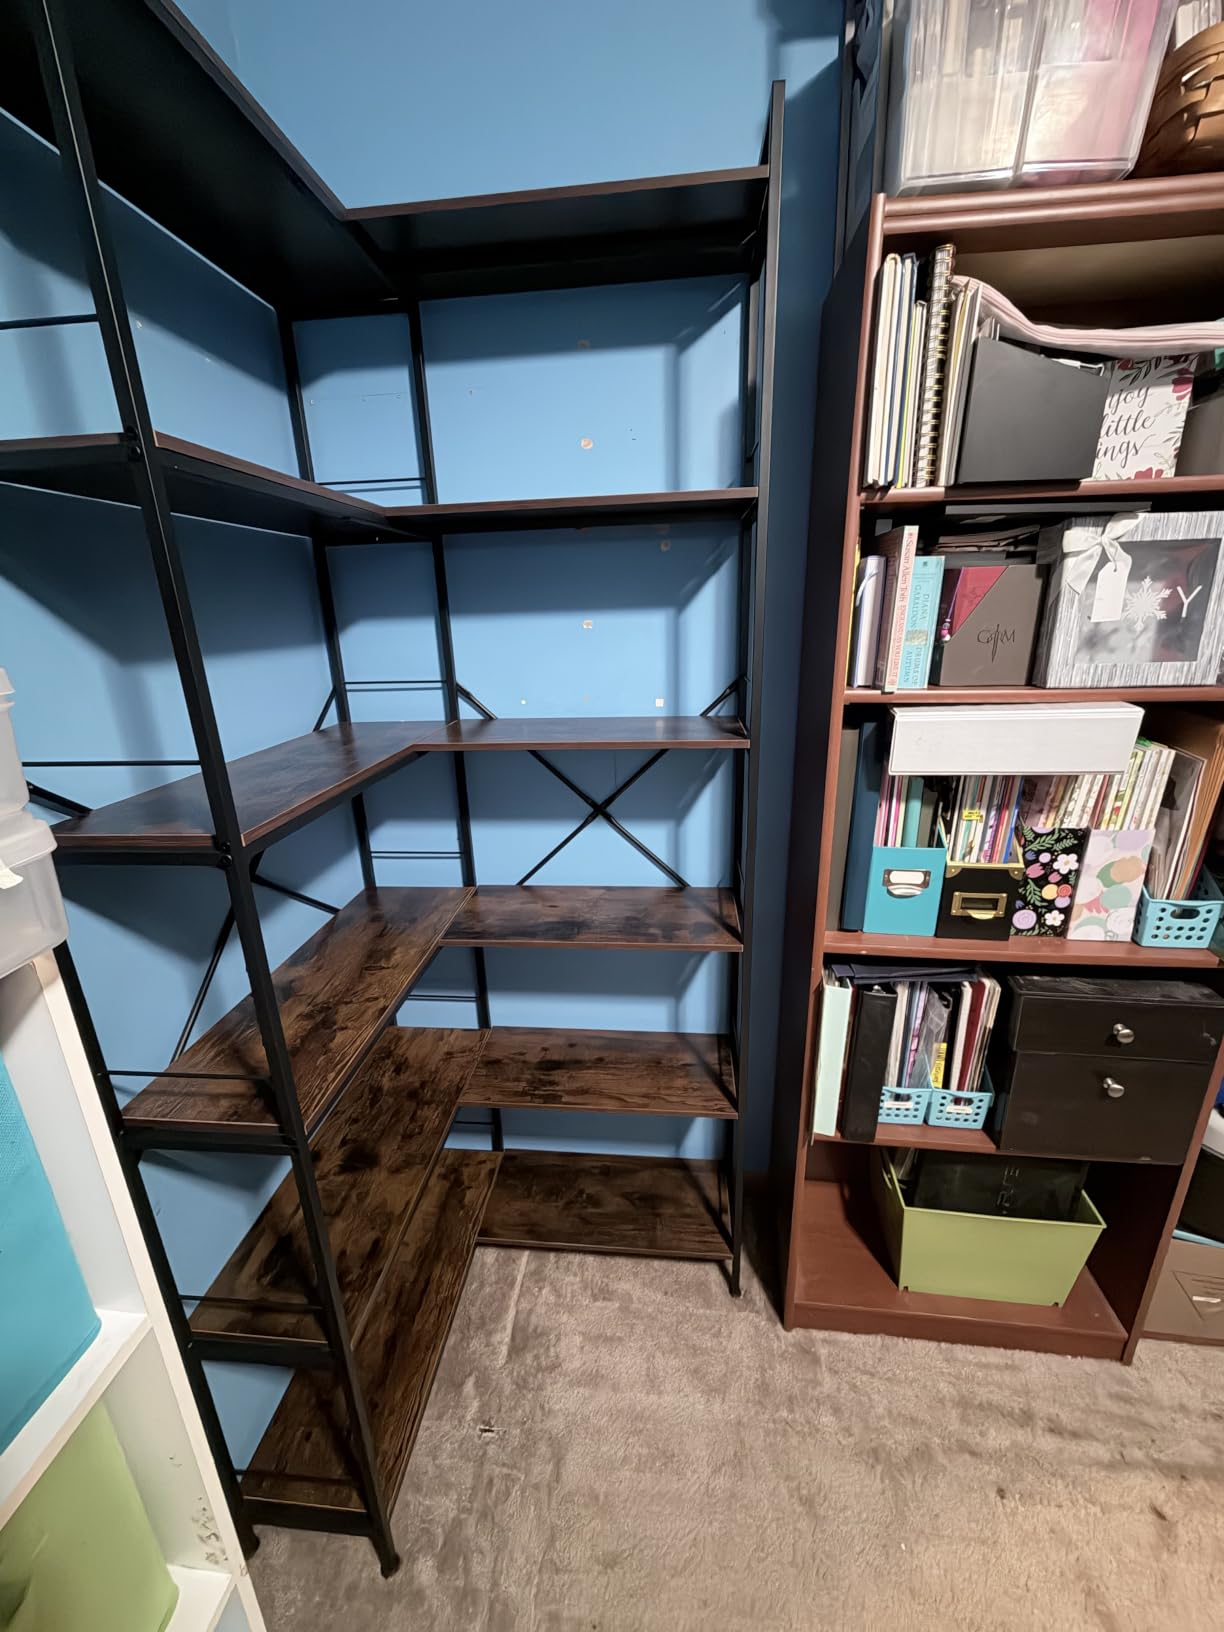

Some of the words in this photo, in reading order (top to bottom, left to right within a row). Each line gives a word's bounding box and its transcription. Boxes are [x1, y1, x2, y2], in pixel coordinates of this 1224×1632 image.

[1101, 409, 1156, 438] little
[1096, 433, 1157, 469] ings
[901, 566, 911, 585] Allen
[909, 584, 922, 629] GABALDON
[919, 593, 930, 621] DIANA
[903, 650, 913, 684] AUTUMN
[913, 646, 923, 674] DRUMS
